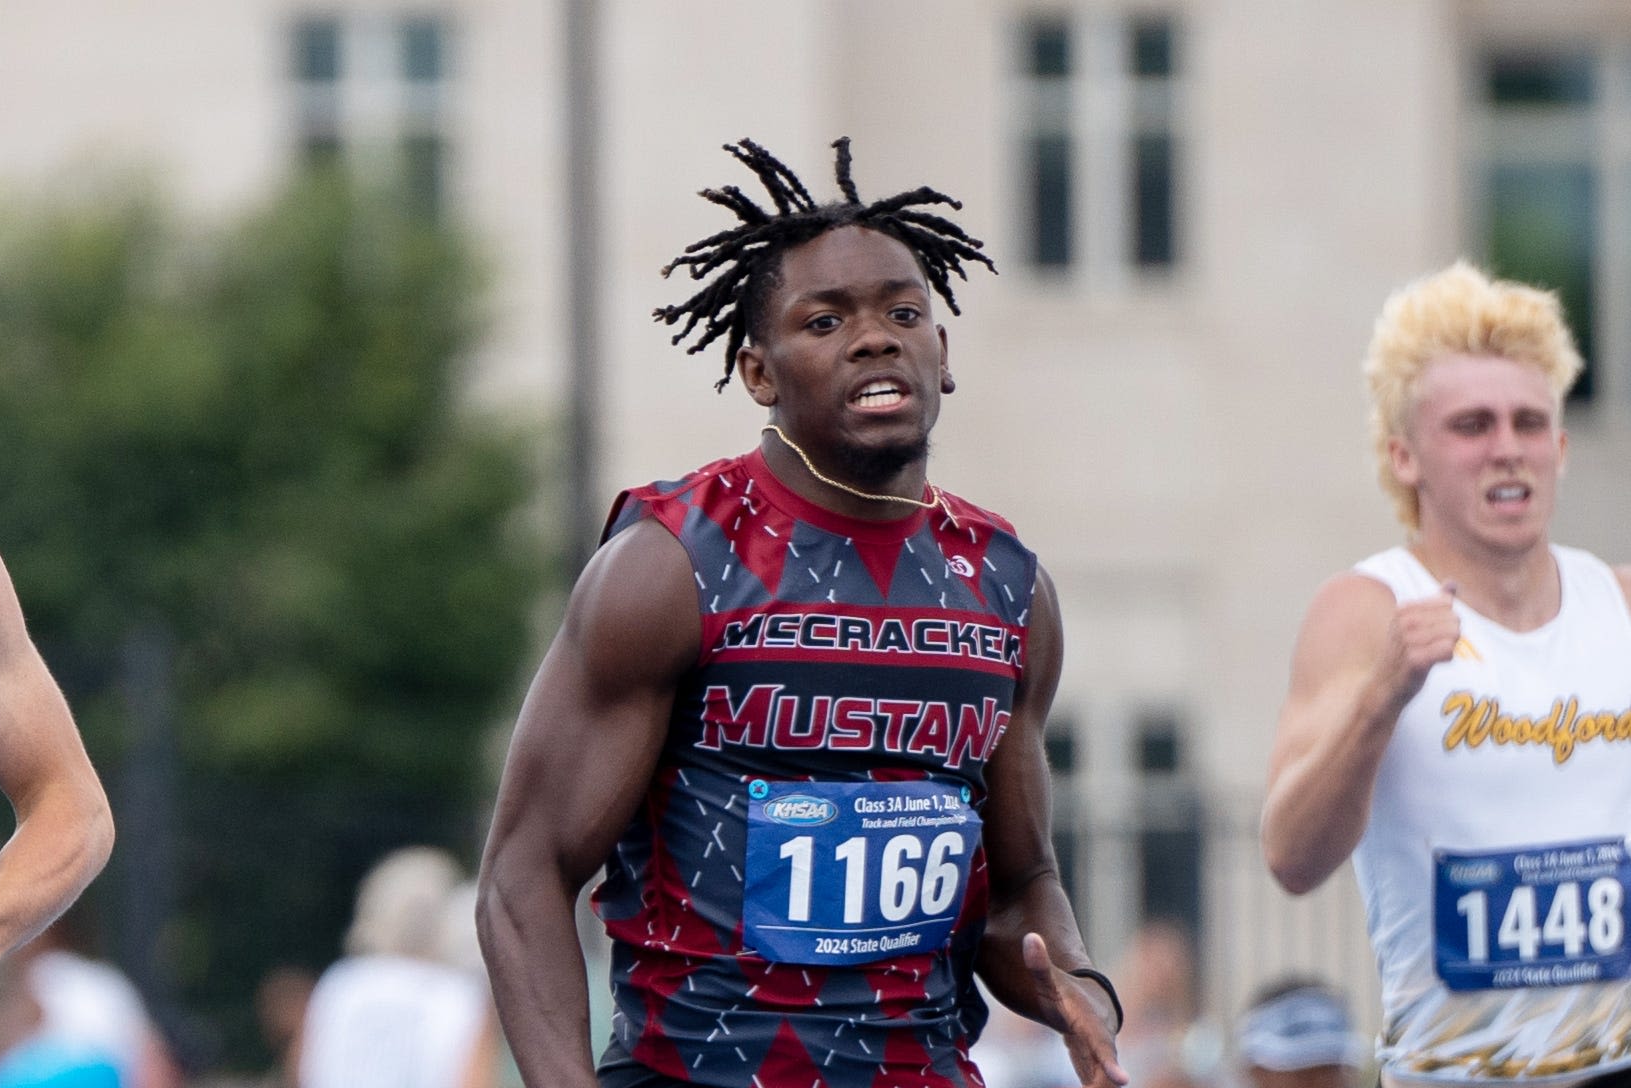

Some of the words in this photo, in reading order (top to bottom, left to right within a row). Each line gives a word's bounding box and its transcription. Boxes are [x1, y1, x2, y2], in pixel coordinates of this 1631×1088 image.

[772, 801, 830, 820] KHSAA
[854, 797, 885, 813] Class
[887, 796, 902, 812] 3A
[904, 795, 930, 811] June
[932, 795, 943, 812] 1,
[862, 818, 881, 829] Track
[881, 817, 897, 828] and
[898, 816, 917, 828] Field
[779, 831, 965, 924] 1166
[1456, 877, 1625, 964] 1448
[815, 938, 849, 954] 2024
[849, 938, 878, 954] State
[879, 932, 921, 952] Qualifier
